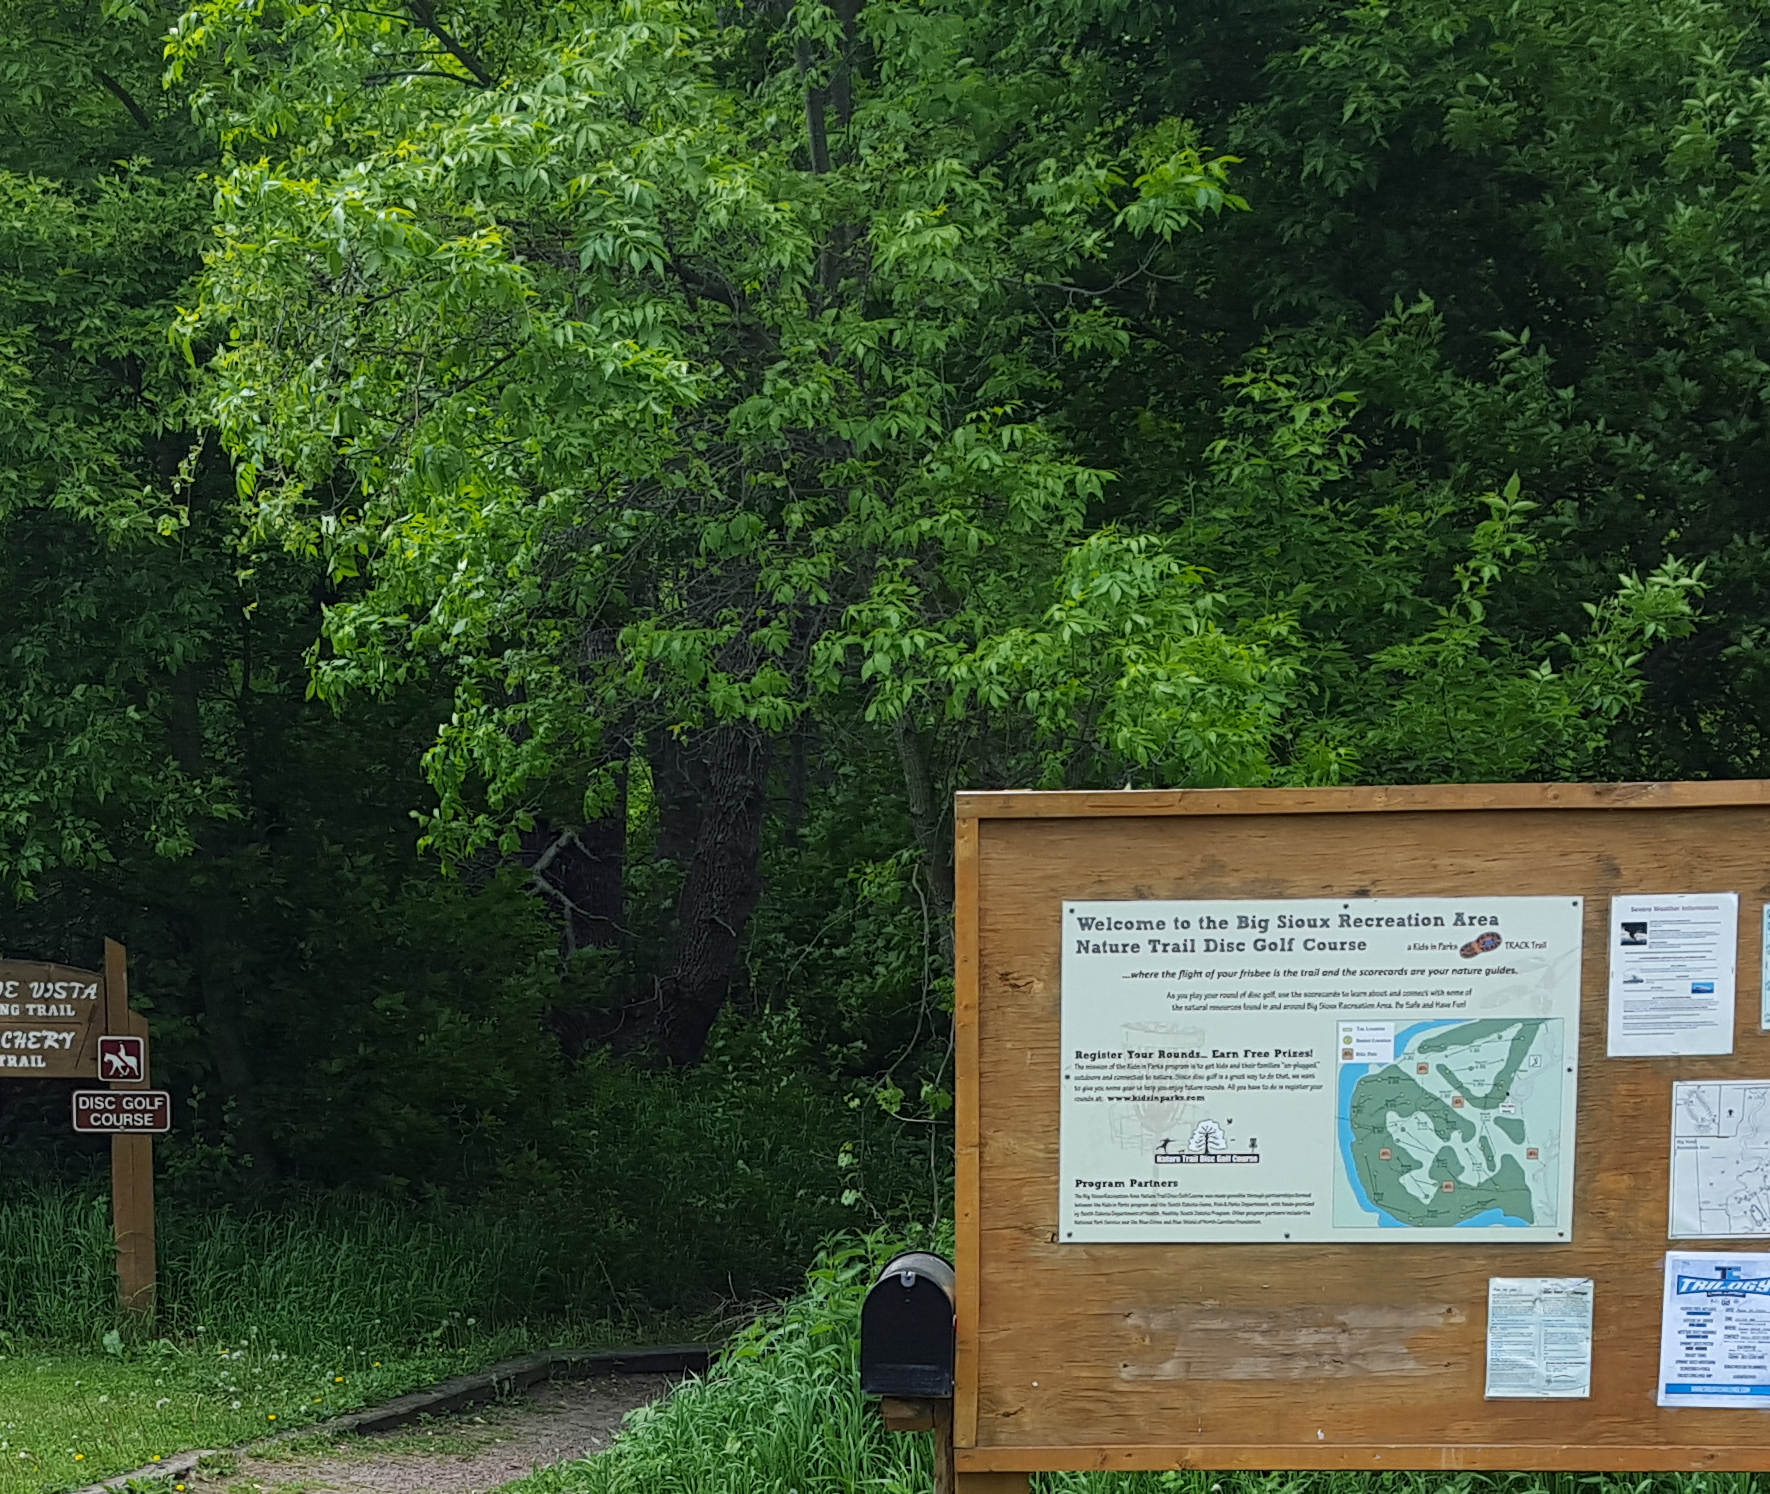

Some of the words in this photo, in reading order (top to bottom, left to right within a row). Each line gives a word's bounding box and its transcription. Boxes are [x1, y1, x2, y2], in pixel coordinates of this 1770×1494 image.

[1077, 916, 1166, 931] Welcome
[1173, 917, 1191, 930] to
[1198, 916, 1229, 930] the
[1236, 915, 1270, 933] Big
[1277, 914, 1330, 929] Sioux
[1338, 913, 1445, 928] Recreation
[1452, 912, 1499, 927] Area
[1076, 939, 1141, 954] Nature
[1148, 939, 1196, 953] Trail
[1203, 938, 1246, 953] Disc
[1252, 938, 1295, 952] Golf
[1303, 938, 1367, 952] Course
[1413, 942, 1429, 950] Kids
[1438, 942, 1458, 950] Parks
[1505, 940, 1530, 949] TRACK
[1531, 941, 1547, 949] Trail
[1161, 970, 1177, 979] the
[1178, 970, 1203, 980] flight
[1205, 969, 1216, 980] of
[1217, 971, 1237, 980] your
[1239, 969, 1271, 979] frisbee
[1273, 969, 1280, 977] is
[1283, 969, 1298, 978] the
[1301, 968, 1320, 977] trail
[1322, 968, 1339, 977] and
[1342, 968, 1357, 977] the
[1359, 967, 1408, 976] scorecards
[1428, 968, 1449, 977] your
[1451, 967, 1482, 976] nature
[1485, 966, 1518, 976] guides.
[29, 981, 98, 1000] VISTA
[1189, 992, 1202, 1001] play
[26, 1004, 76, 1017] TRAIL
[1075, 1050, 1122, 1062] Register
[1127, 1050, 1154, 1059] Your
[1212, 1049, 1239, 1058] Earn
[1244, 1049, 1270, 1058] Free
[1274, 1049, 1313, 1058] Prizes!
[79, 1097, 116, 1110] DISC
[122, 1097, 164, 1110] GOLF
[90, 1113, 154, 1127] COURSE
[1075, 1179, 1125, 1190] Program
[1130, 1179, 1178, 1188] Partners
